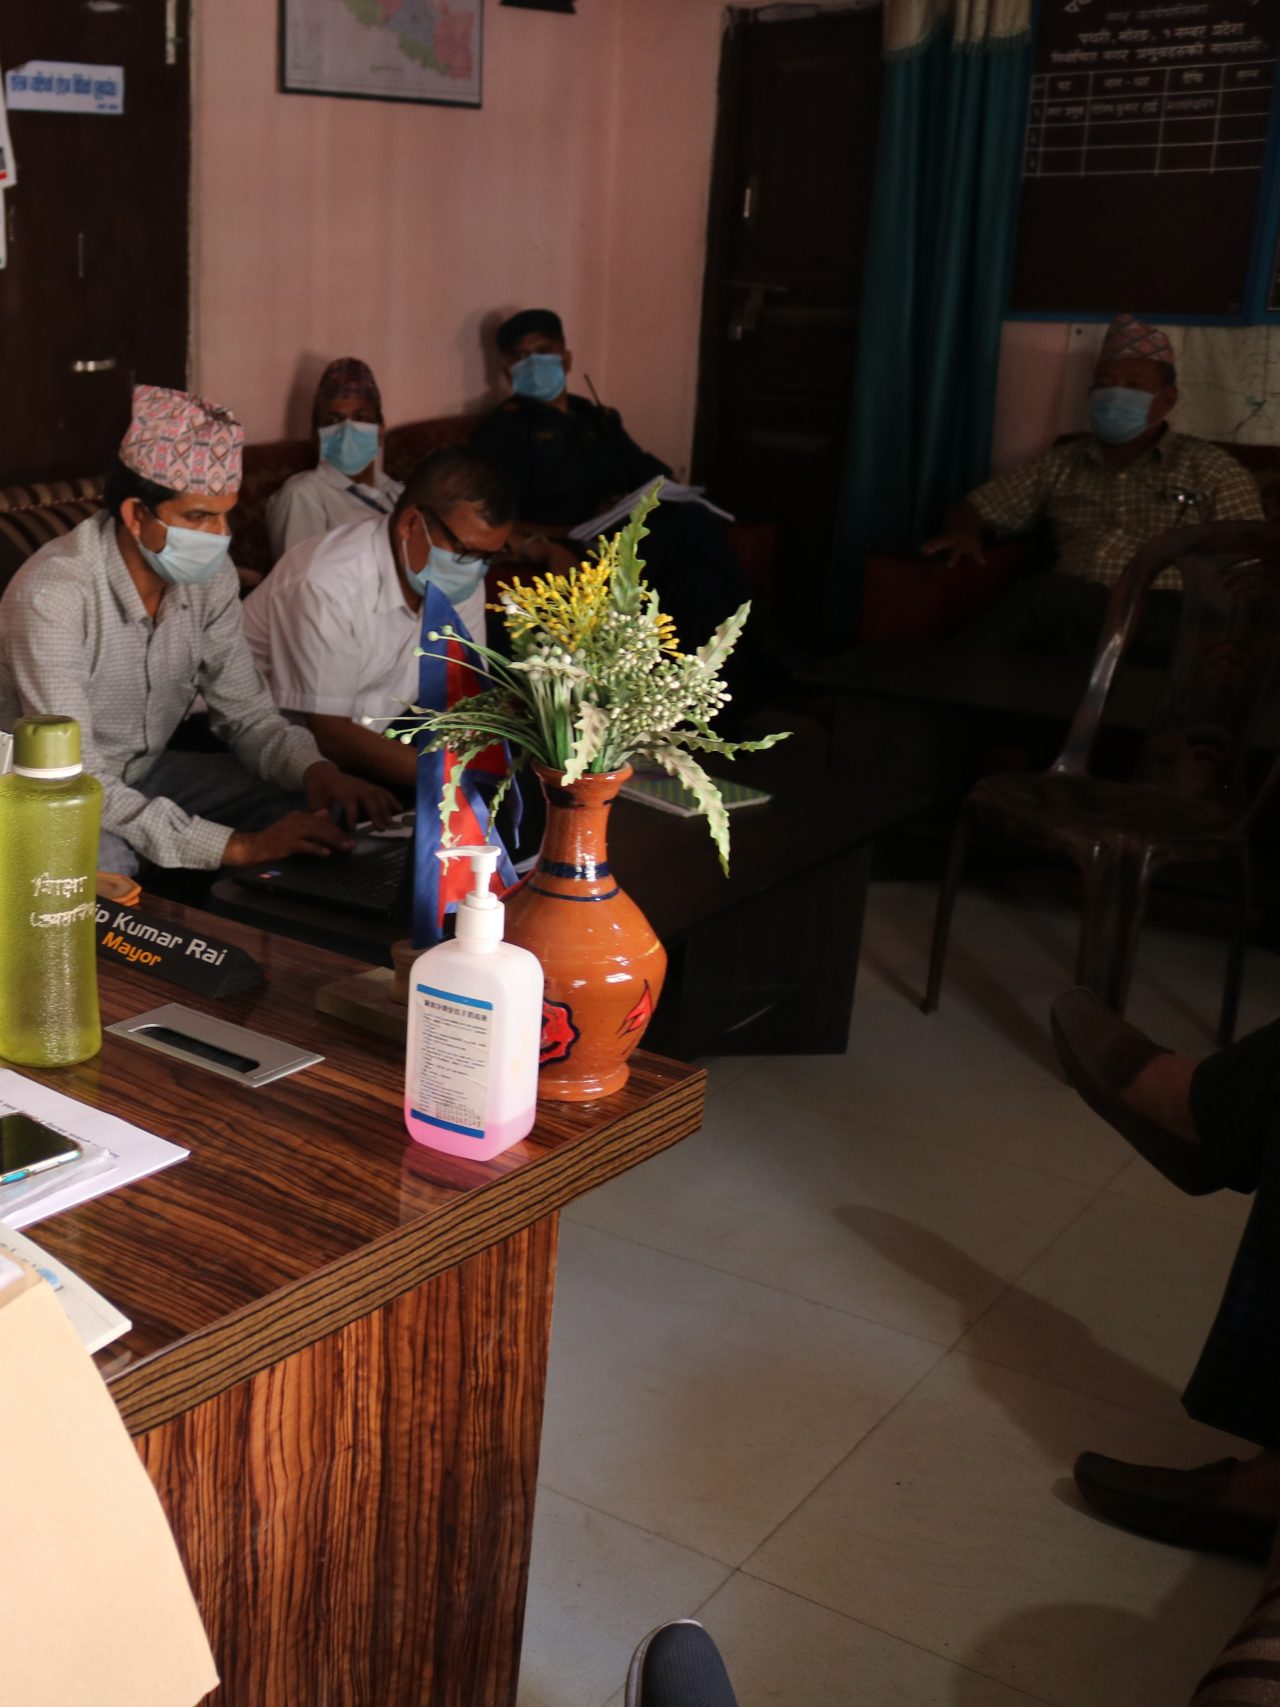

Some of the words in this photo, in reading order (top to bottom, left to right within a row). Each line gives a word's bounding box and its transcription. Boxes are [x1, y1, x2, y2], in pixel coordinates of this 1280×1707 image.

[101, 931, 162, 966] Mayor
[112, 912, 183, 949] Kumar
[185, 938, 228, 966] Rai
